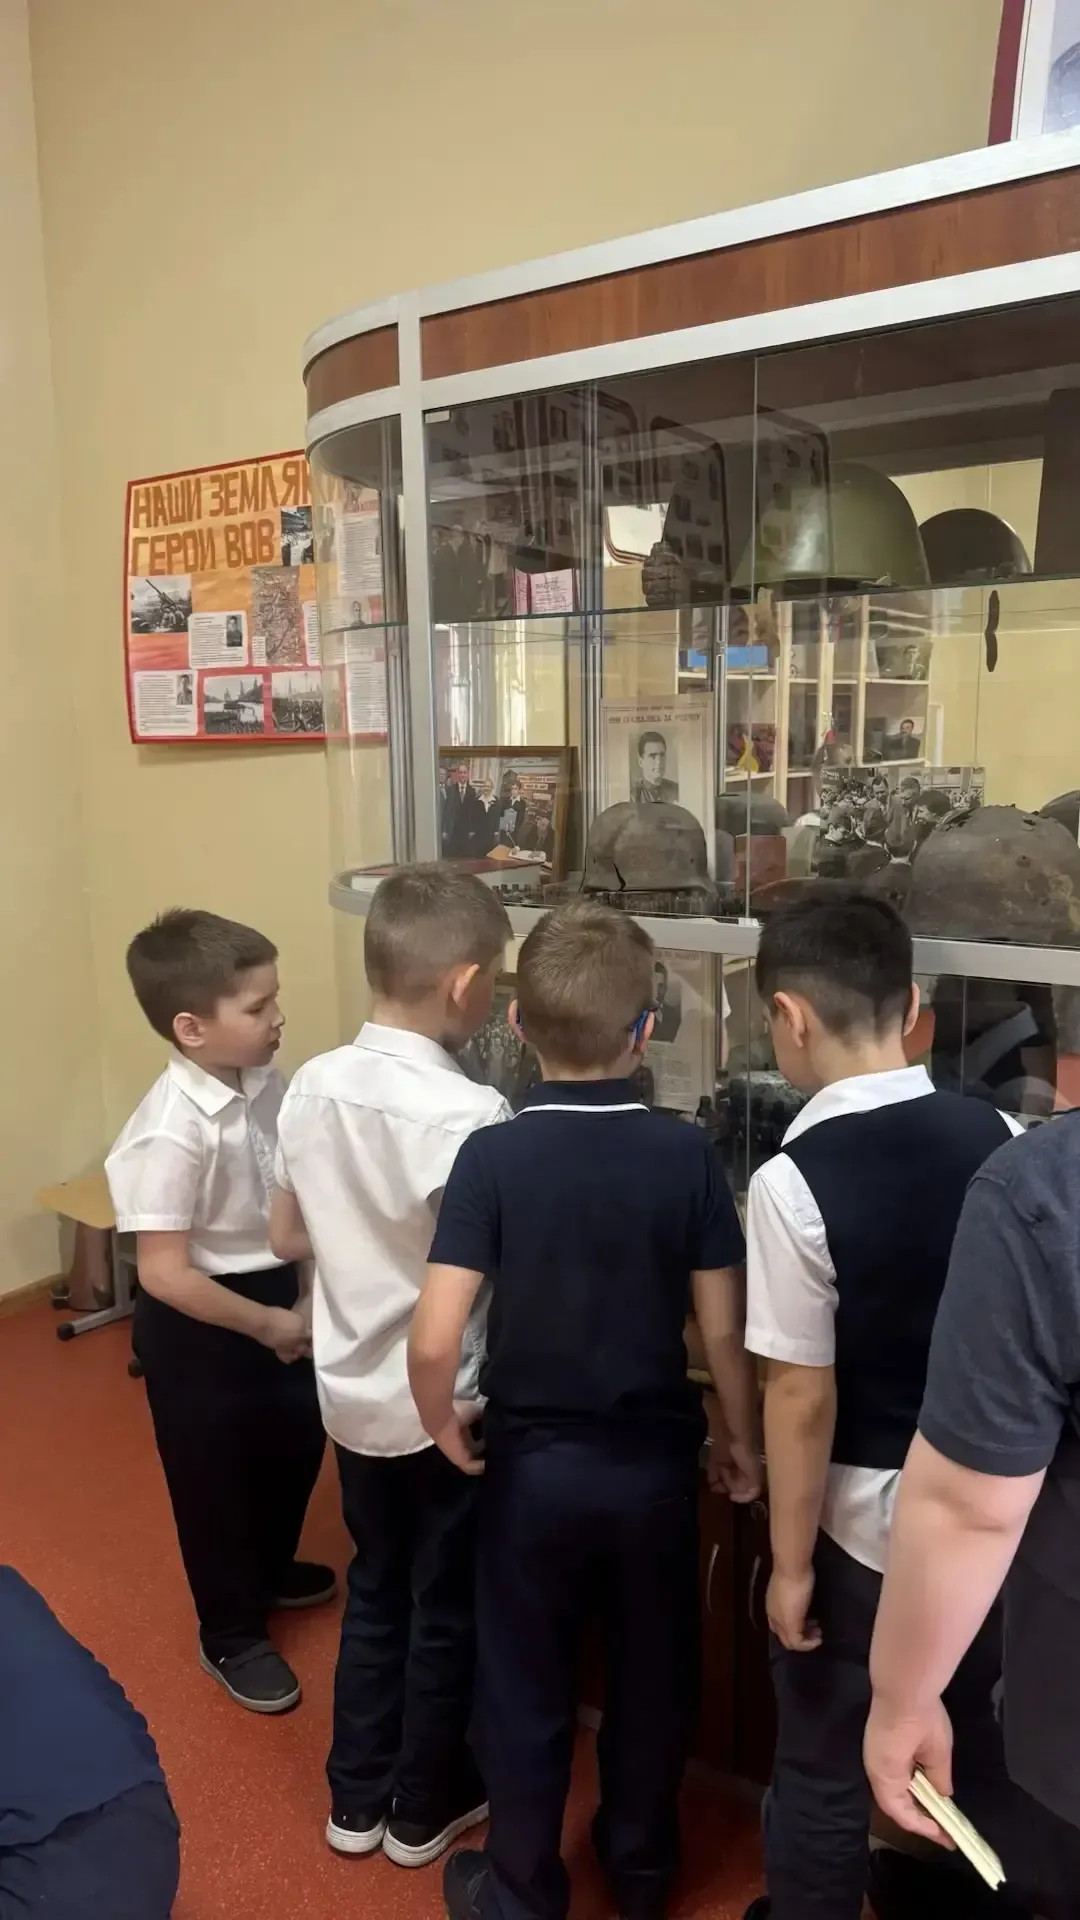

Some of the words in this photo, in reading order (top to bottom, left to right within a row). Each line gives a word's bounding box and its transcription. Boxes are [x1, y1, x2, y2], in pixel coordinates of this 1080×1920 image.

[132, 476, 203, 528] НАШИ
[132, 526, 216, 576] ГЕРОИ
[223, 518, 275, 568] ВОВ
